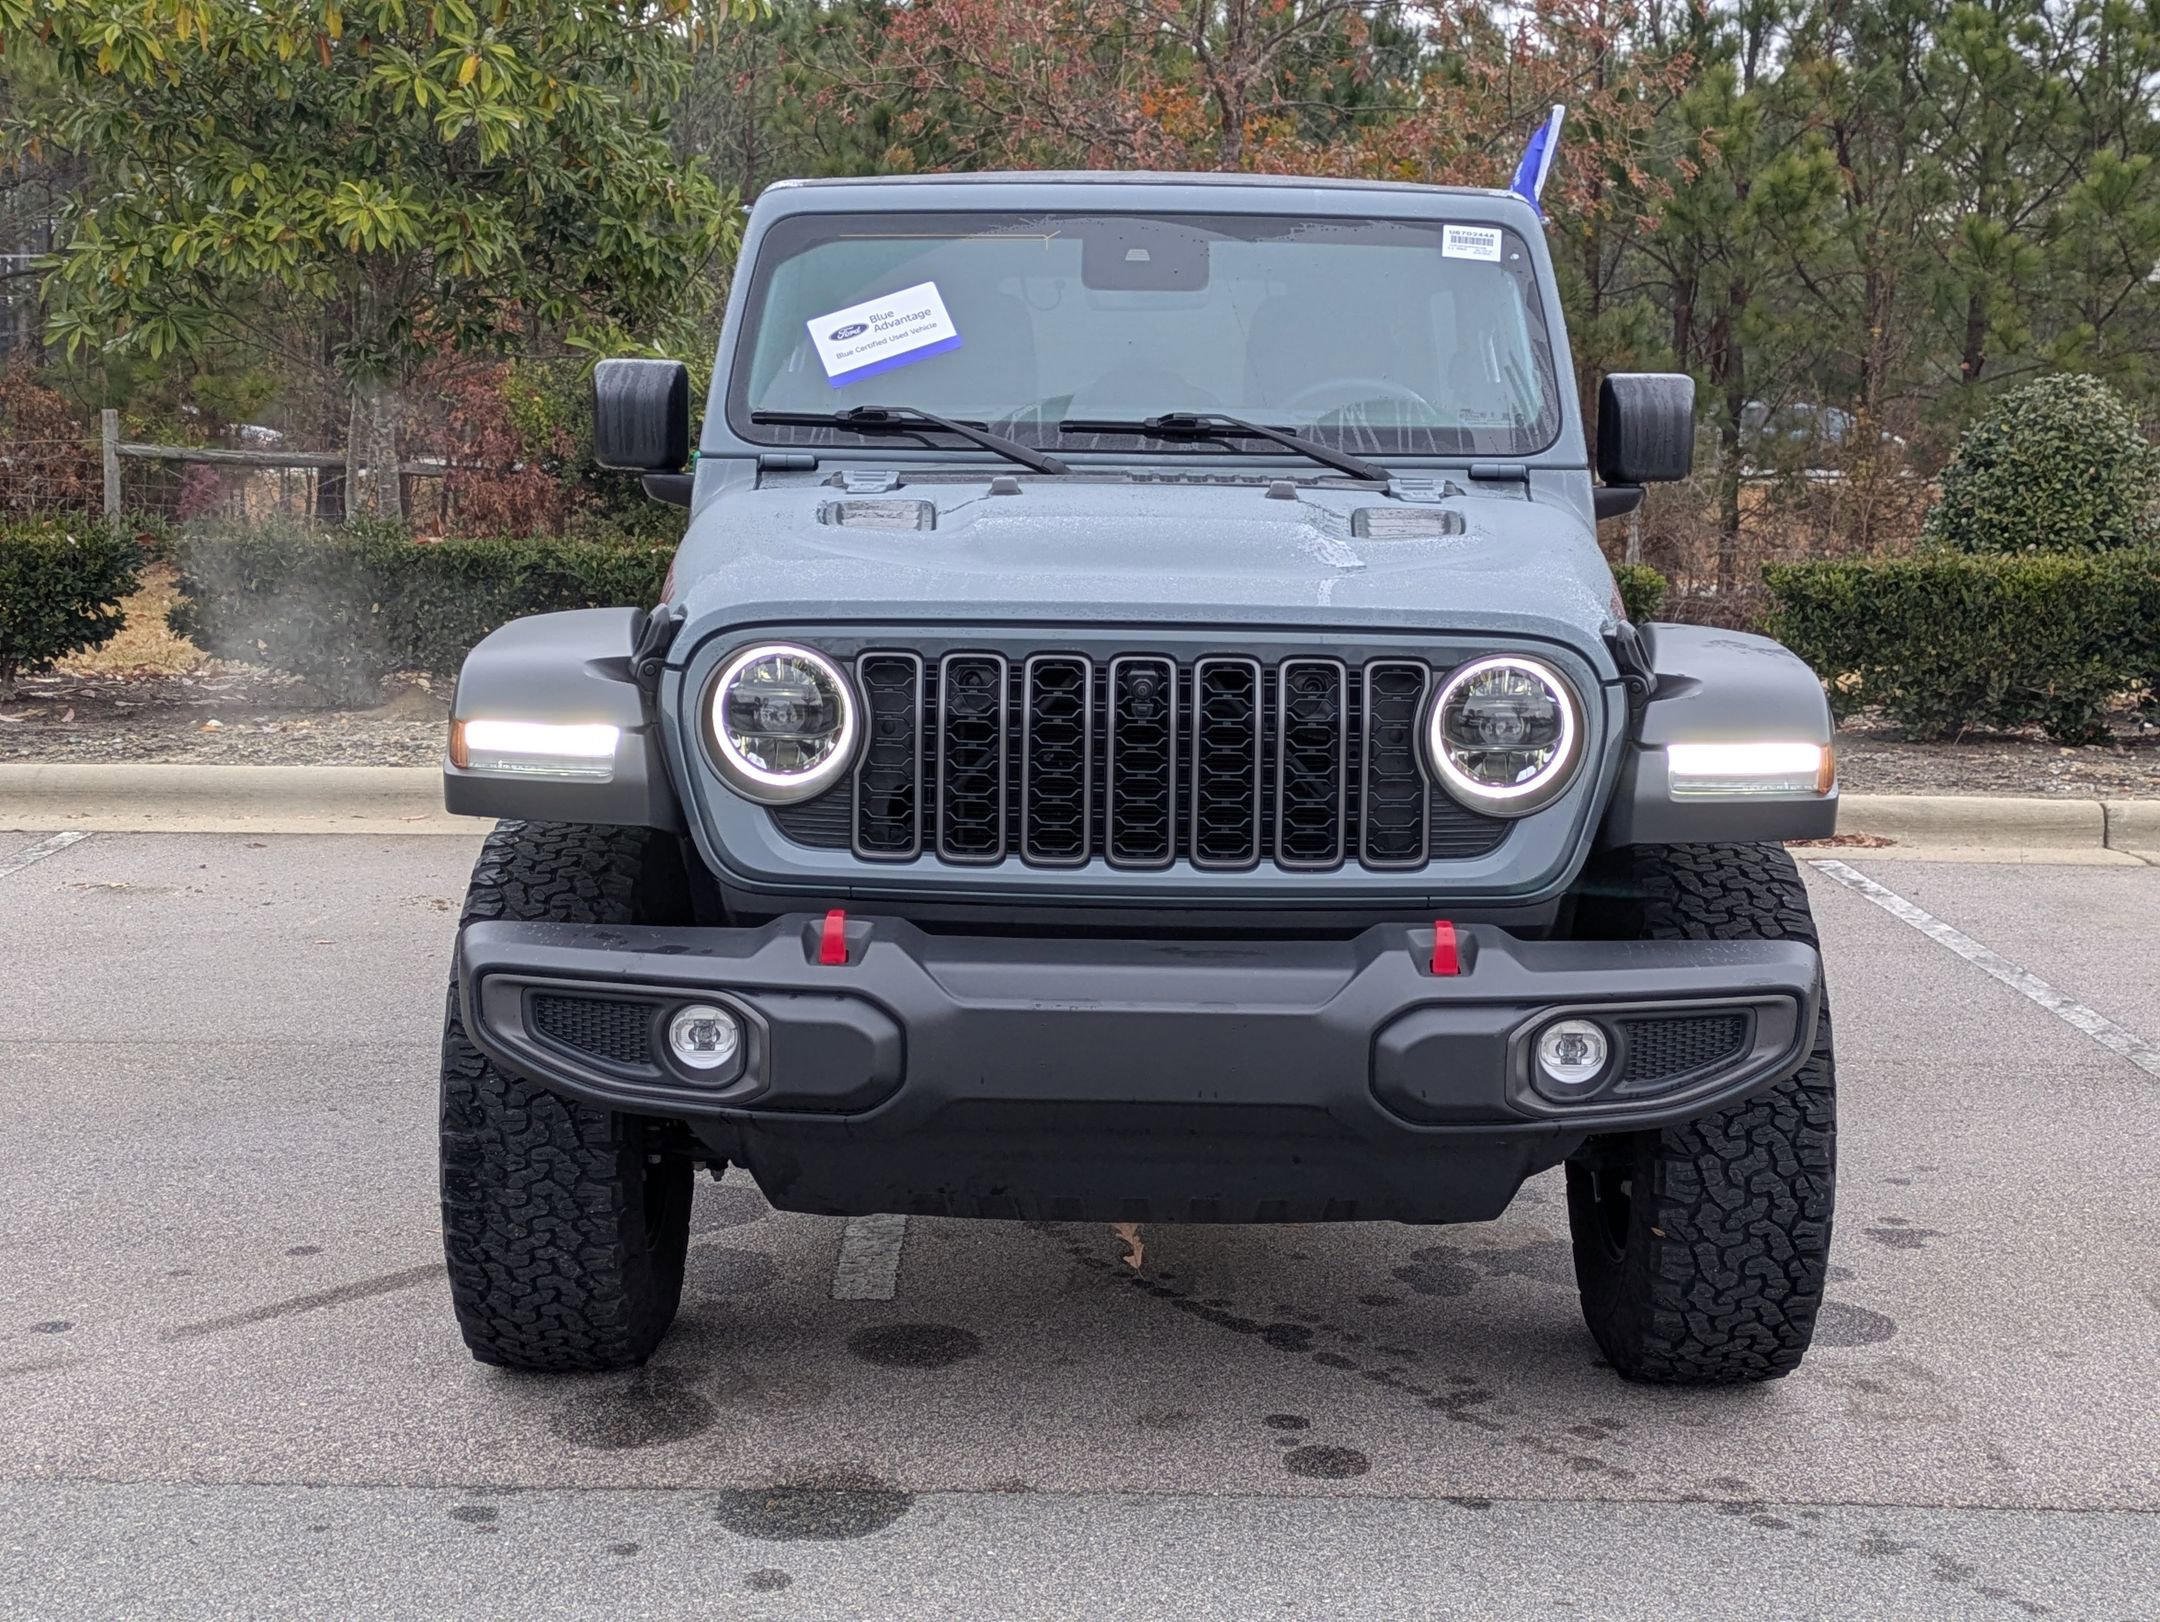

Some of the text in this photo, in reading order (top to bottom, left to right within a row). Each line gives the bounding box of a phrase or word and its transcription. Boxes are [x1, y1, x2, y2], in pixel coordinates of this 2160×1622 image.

[869, 310, 895, 324] Blue
[874, 308, 932, 333] Advantage
[835, 325, 862, 340] Ford
[836, 321, 937, 360] Blue Certified Used Vehicle
